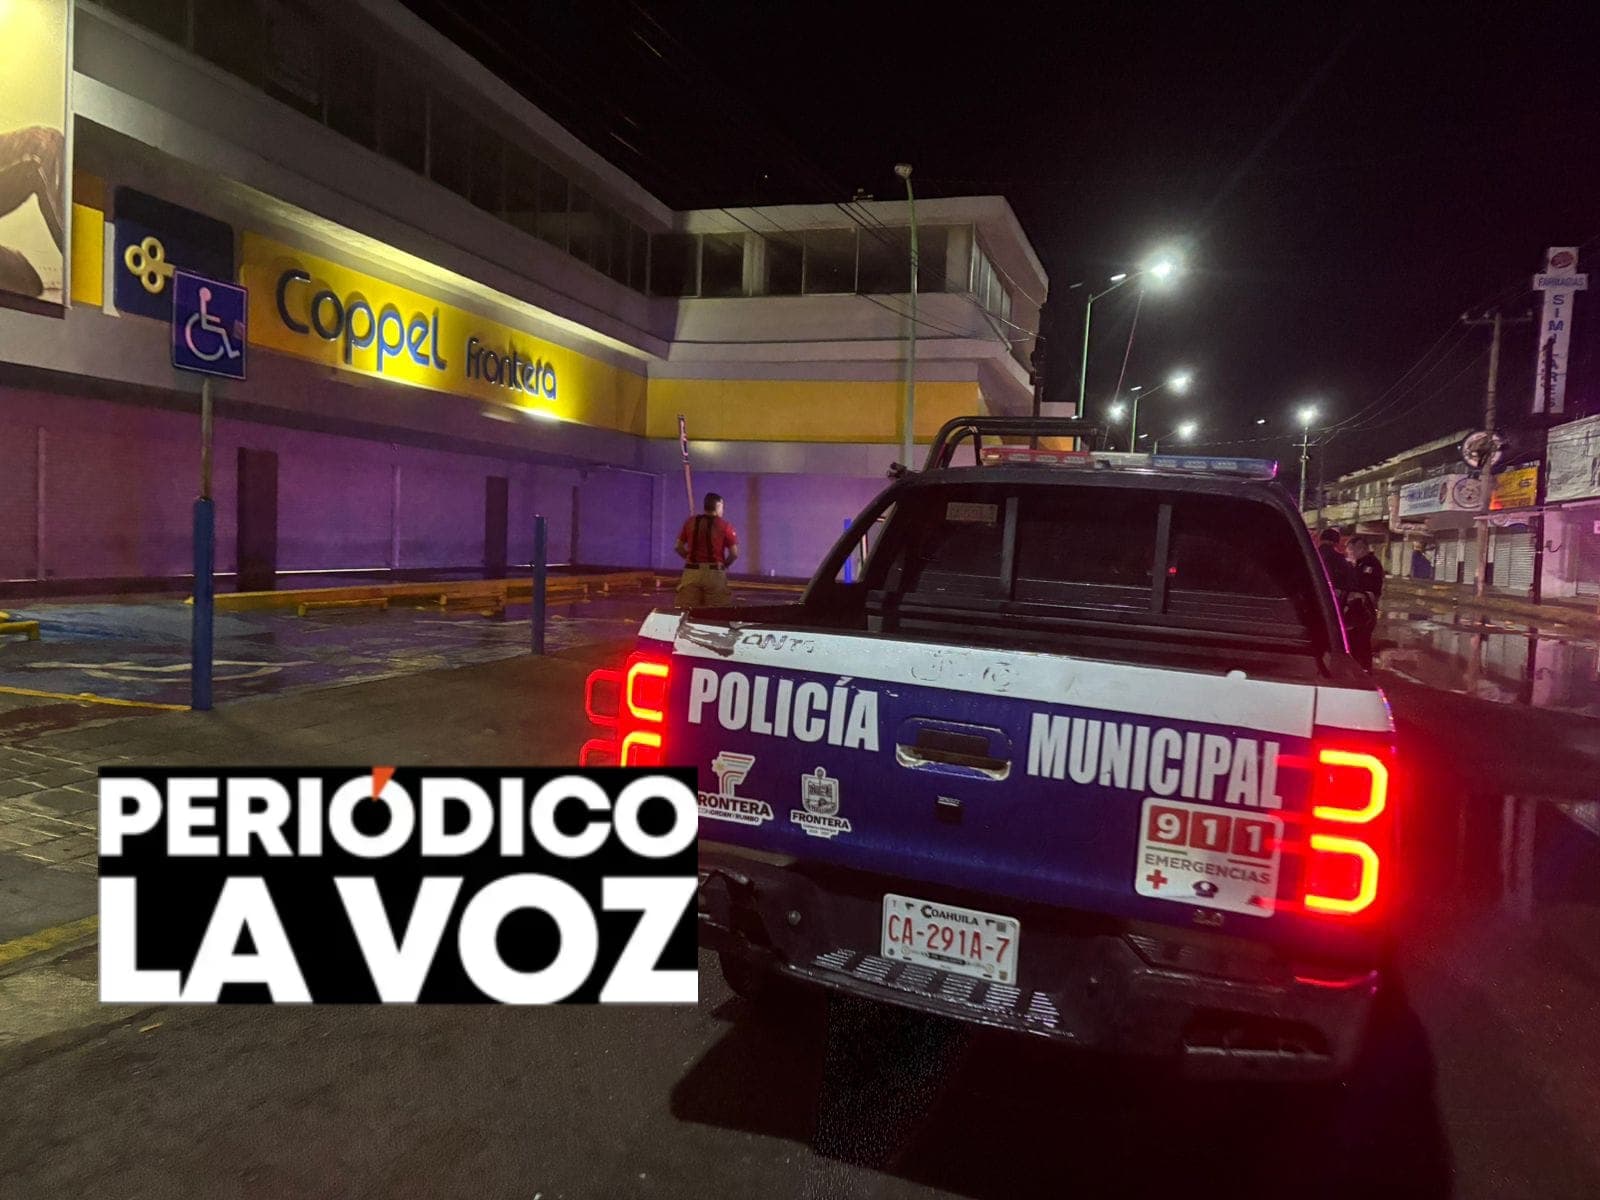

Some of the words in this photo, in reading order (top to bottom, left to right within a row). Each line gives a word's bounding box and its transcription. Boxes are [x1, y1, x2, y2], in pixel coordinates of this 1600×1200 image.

[277, 269, 448, 372] Coppel
[688, 667, 880, 751] POLICÍA
[1027, 712, 1283, 809] MUNICIPAL
[698, 793, 770, 817] RONTERA
[792, 811, 849, 829] FRONTERA
[1157, 813, 1262, 852] 911
[1145, 853, 1271, 885] EMERGENCIAS
[888, 915, 1010, 963] CA-291A-7
